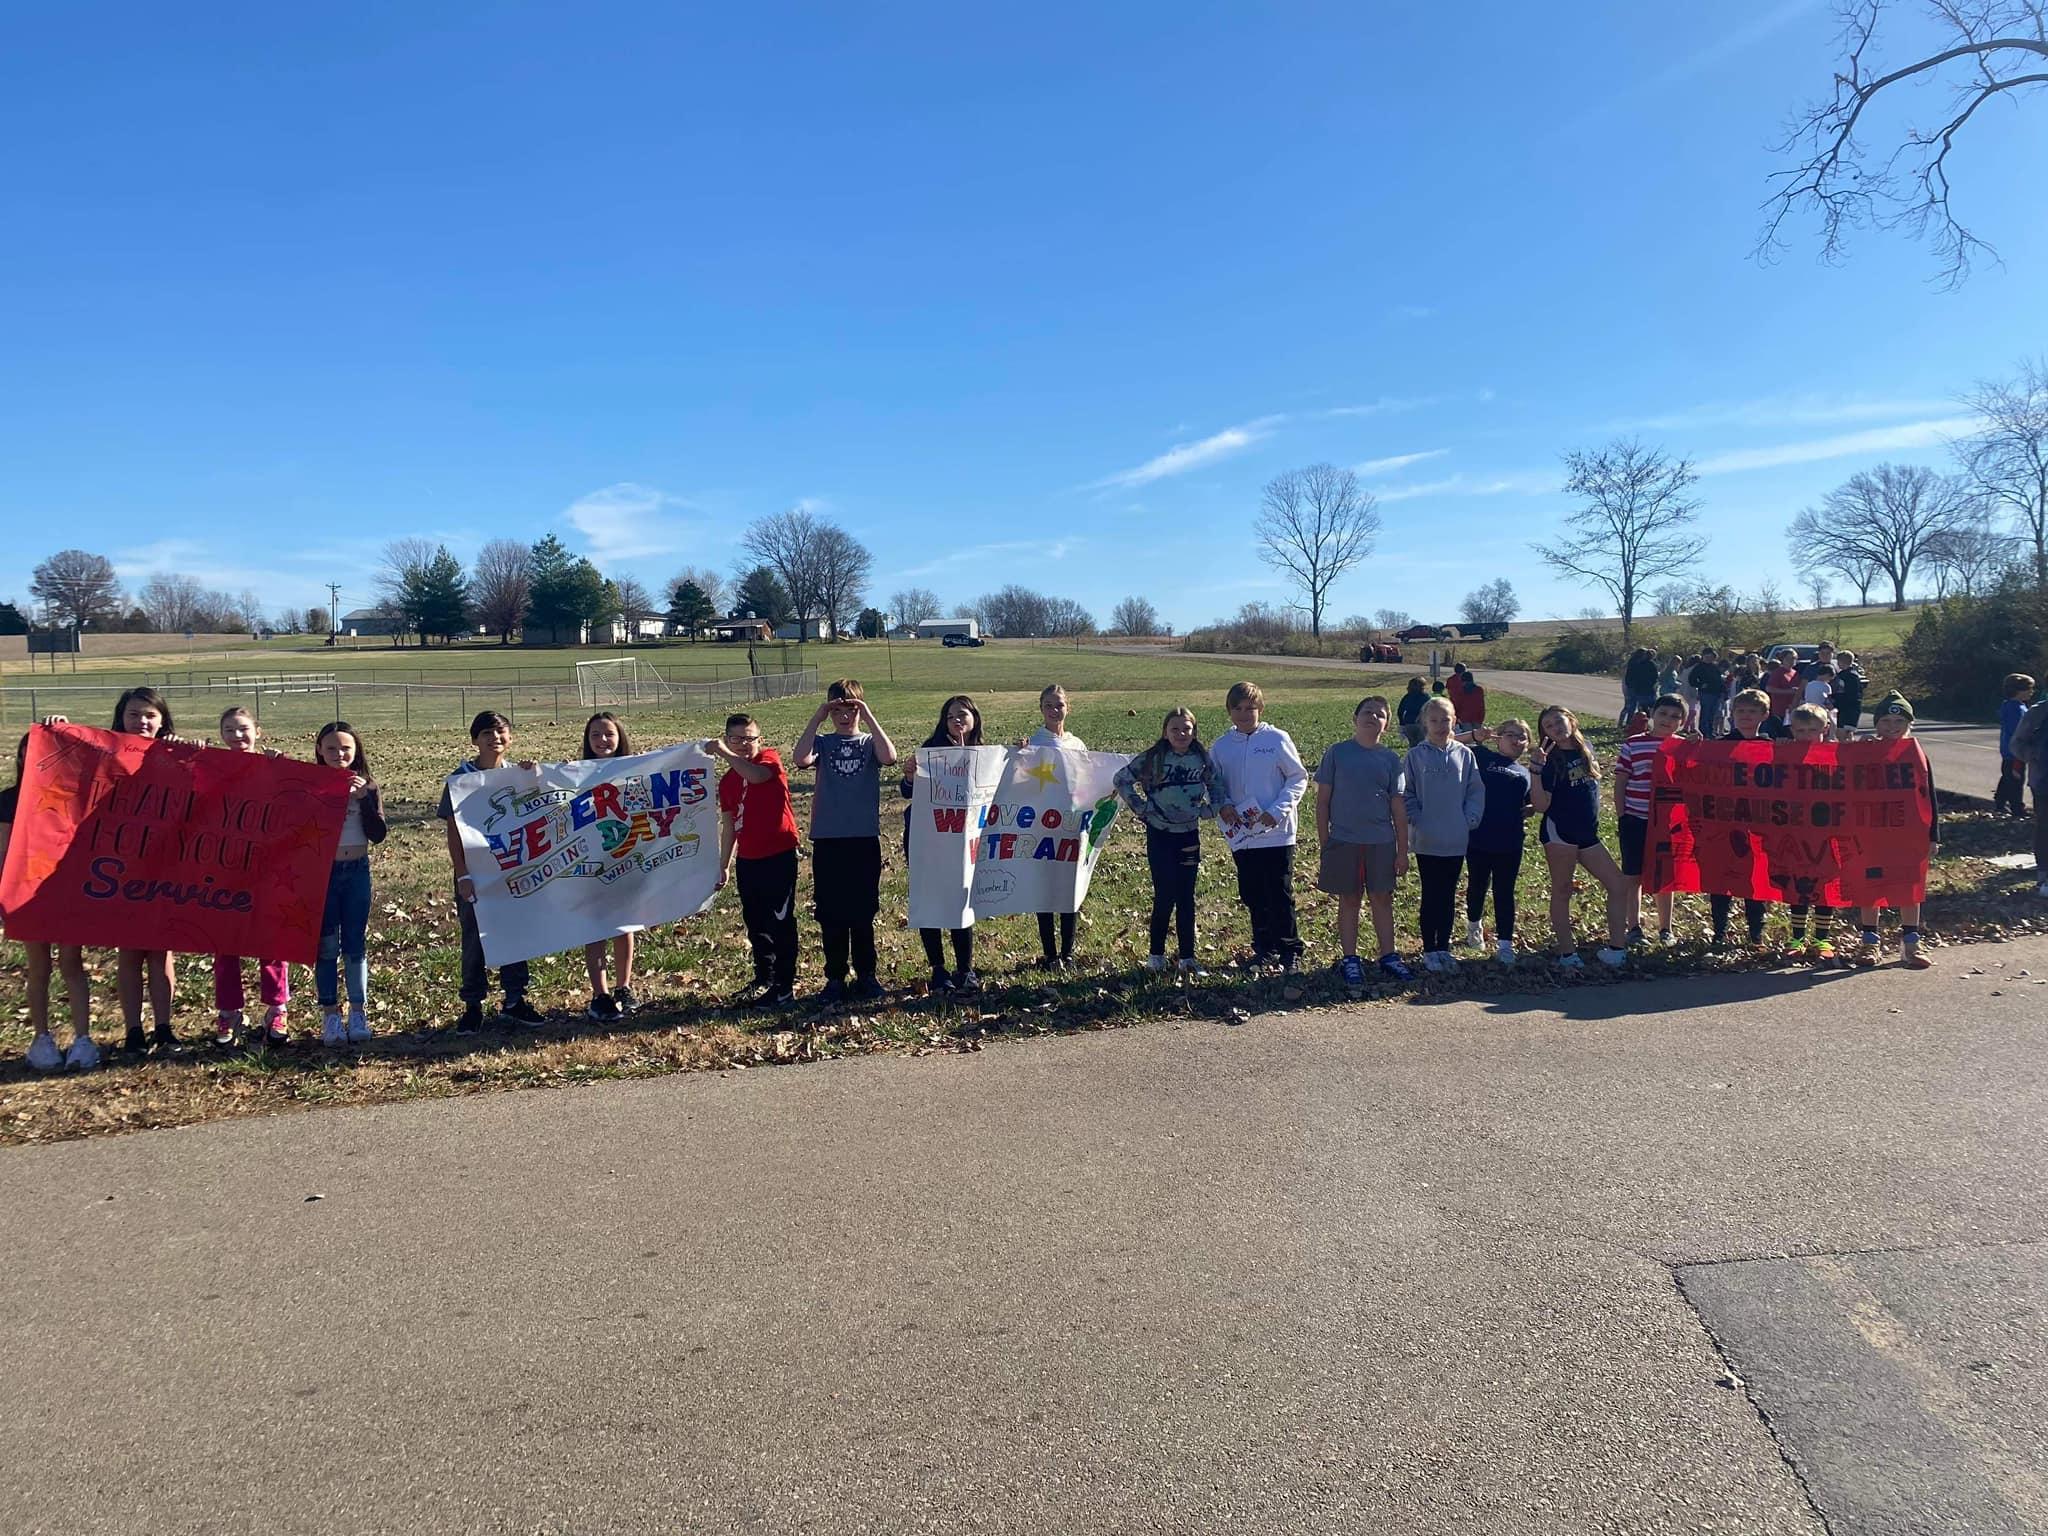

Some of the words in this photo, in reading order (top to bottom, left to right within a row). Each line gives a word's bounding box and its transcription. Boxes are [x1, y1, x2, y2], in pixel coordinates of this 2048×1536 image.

[554, 791, 567, 801] 11
[1753, 762, 1788, 789] OF
[1794, 763, 1846, 790] THE
[88, 776, 204, 824] THANK
[222, 793, 286, 834] YOU
[485, 768, 708, 870] VETERANS
[1811, 801, 1846, 828] OF
[1854, 800, 1905, 828] THE
[177, 826, 267, 874] YOUR
[596, 807, 681, 859] DAY
[83, 856, 254, 913] Service
[507, 838, 589, 895] HONORING
[573, 864, 593, 876] ALL
[604, 860, 633, 881] WHO
